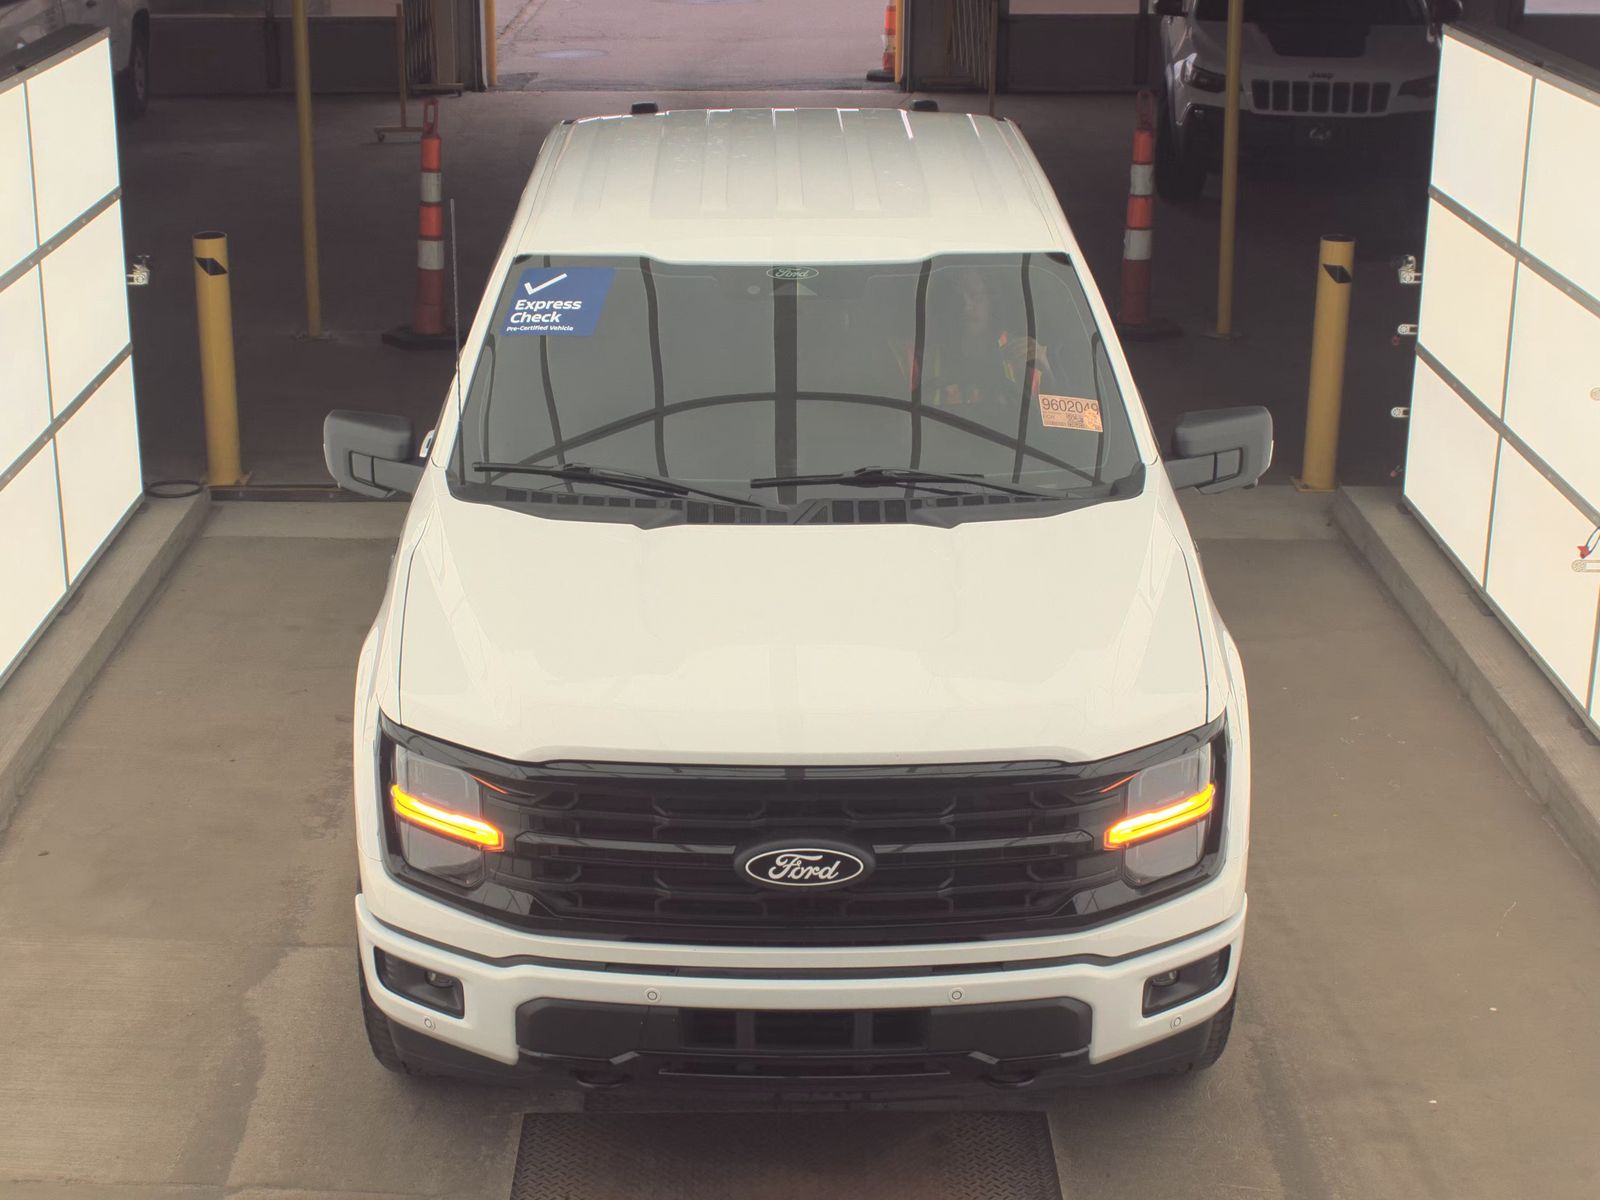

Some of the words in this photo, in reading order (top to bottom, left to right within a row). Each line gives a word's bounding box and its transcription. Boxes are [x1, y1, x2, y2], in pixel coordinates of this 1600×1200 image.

[775, 268, 810, 278] Ford
[515, 299, 582, 312] Express
[510, 311, 562, 324] Check
[1041, 398, 1099, 415] 9602049
[768, 853, 841, 880] Ford
